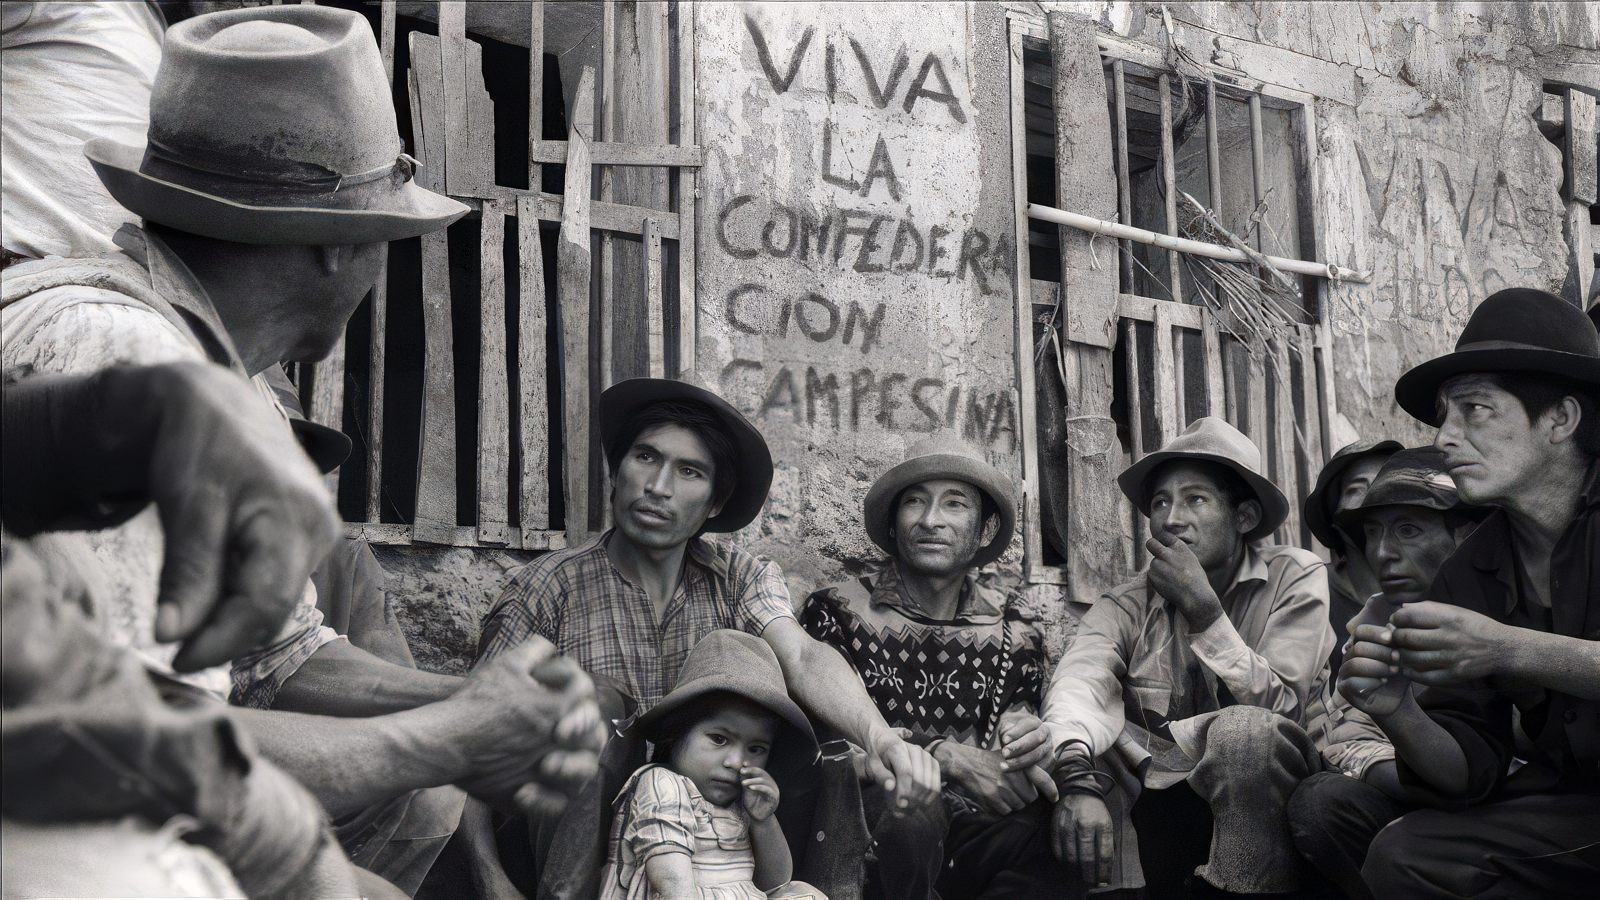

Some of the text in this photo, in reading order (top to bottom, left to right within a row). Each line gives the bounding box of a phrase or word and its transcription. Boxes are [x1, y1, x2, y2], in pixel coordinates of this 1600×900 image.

[744, 10, 968, 125] VIVA
[821, 117, 900, 203] LA
[715, 195, 1013, 296] CONFEDERA
[727, 283, 886, 354] CION
[720, 357, 1018, 456] CAMPESINA
